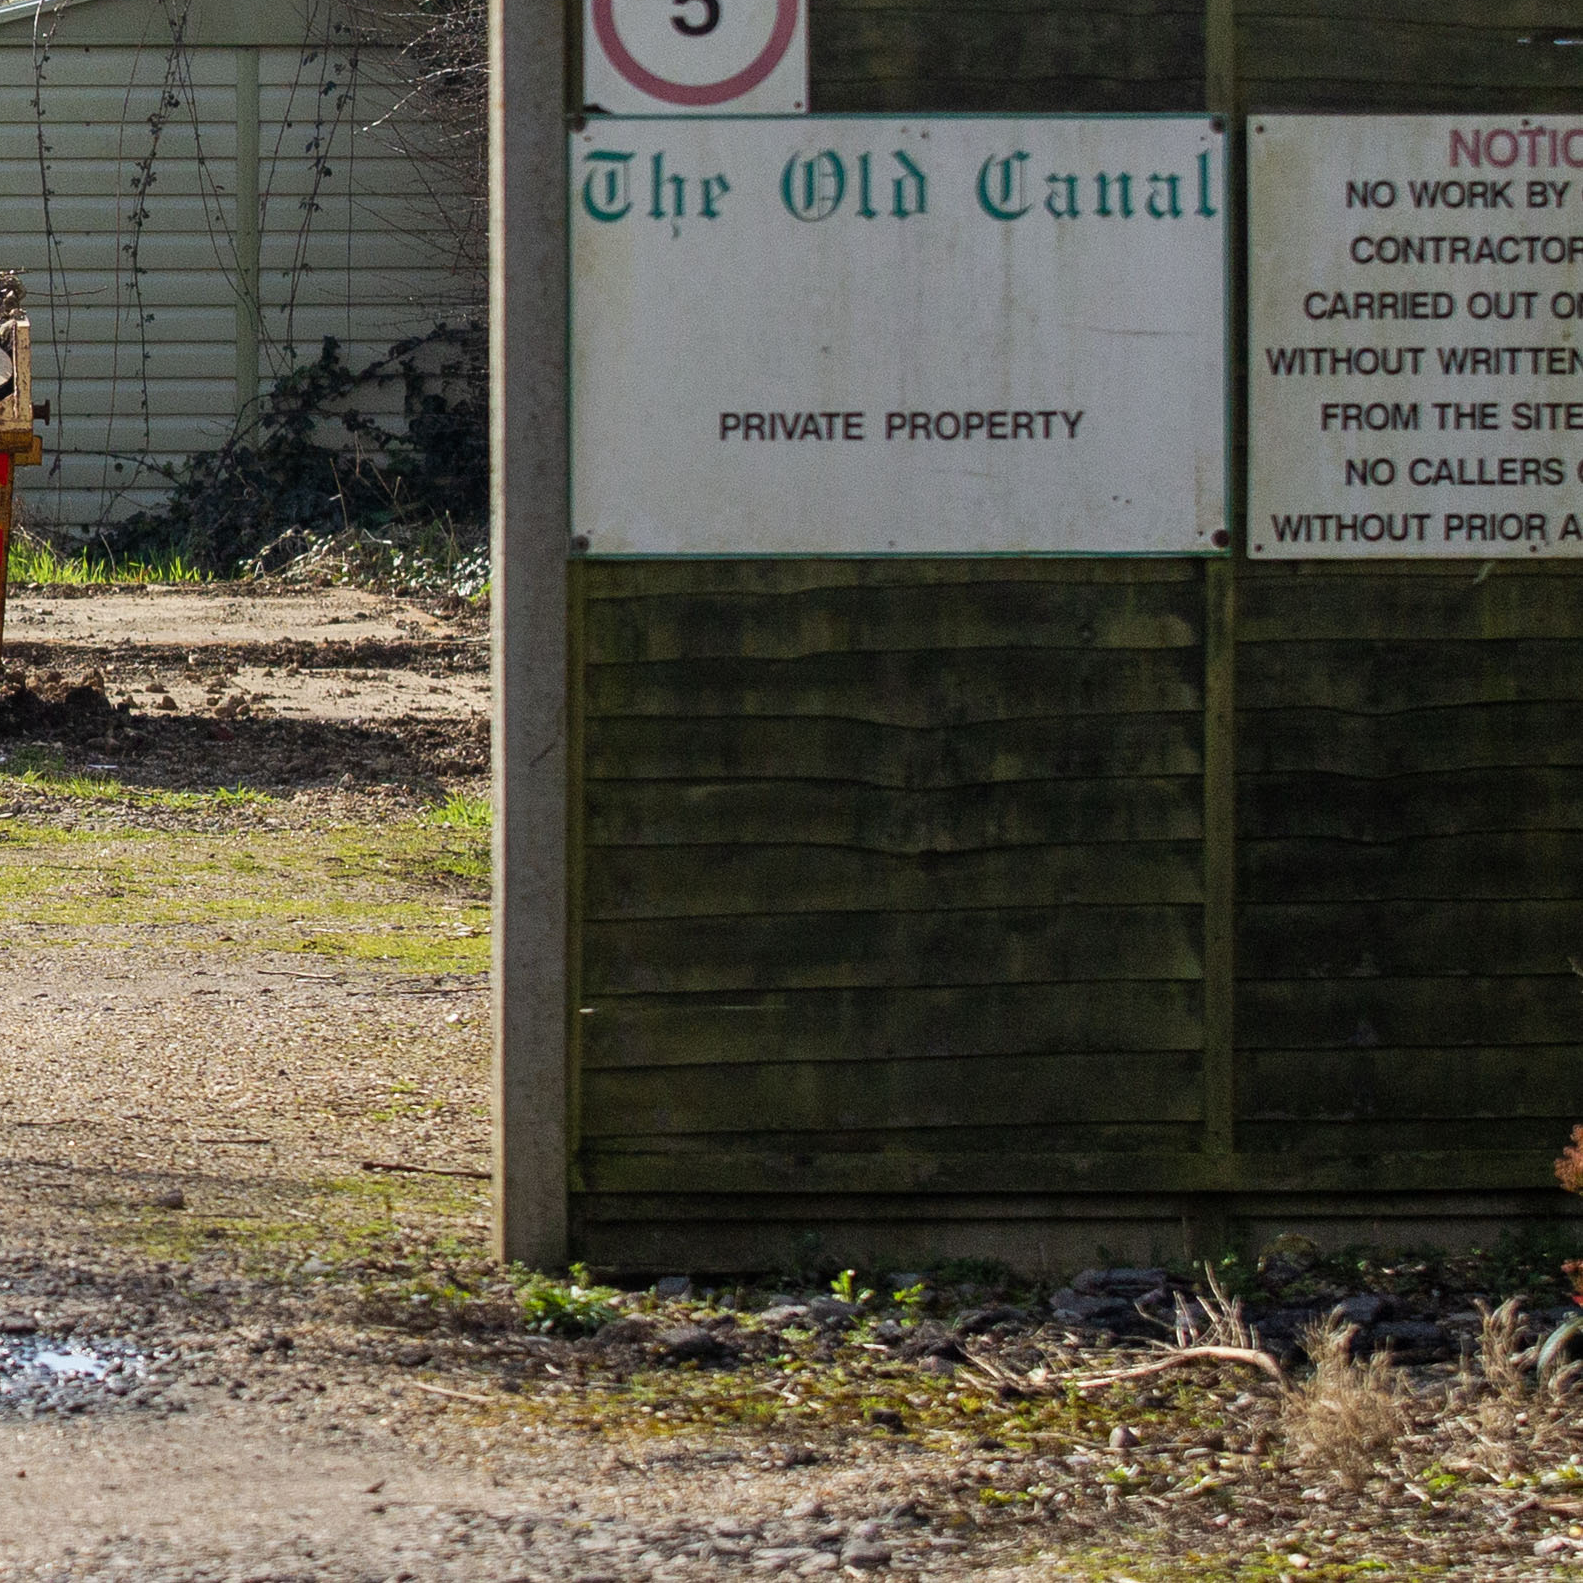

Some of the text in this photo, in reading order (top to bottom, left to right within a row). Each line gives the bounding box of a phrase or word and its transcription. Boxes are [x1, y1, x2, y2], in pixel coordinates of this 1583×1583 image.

[580, 150, 1217, 237] The Old Canal
[1347, 180, 1570, 209] NO WORK BY
[1304, 291, 1583, 320] CARRIED OUT O
[1266, 347, 1425, 375] WITHOUT
[720, 411, 1083, 441] PRIVATE PROPERTY
[1322, 402, 1583, 431] FROM THE SITE
[1346, 458, 1396, 486] NO
[1409, 457, 1565, 486] CALLERS
[1271, 513, 1431, 542] WITHOUT
[1445, 513, 1547, 541] PRIOR
